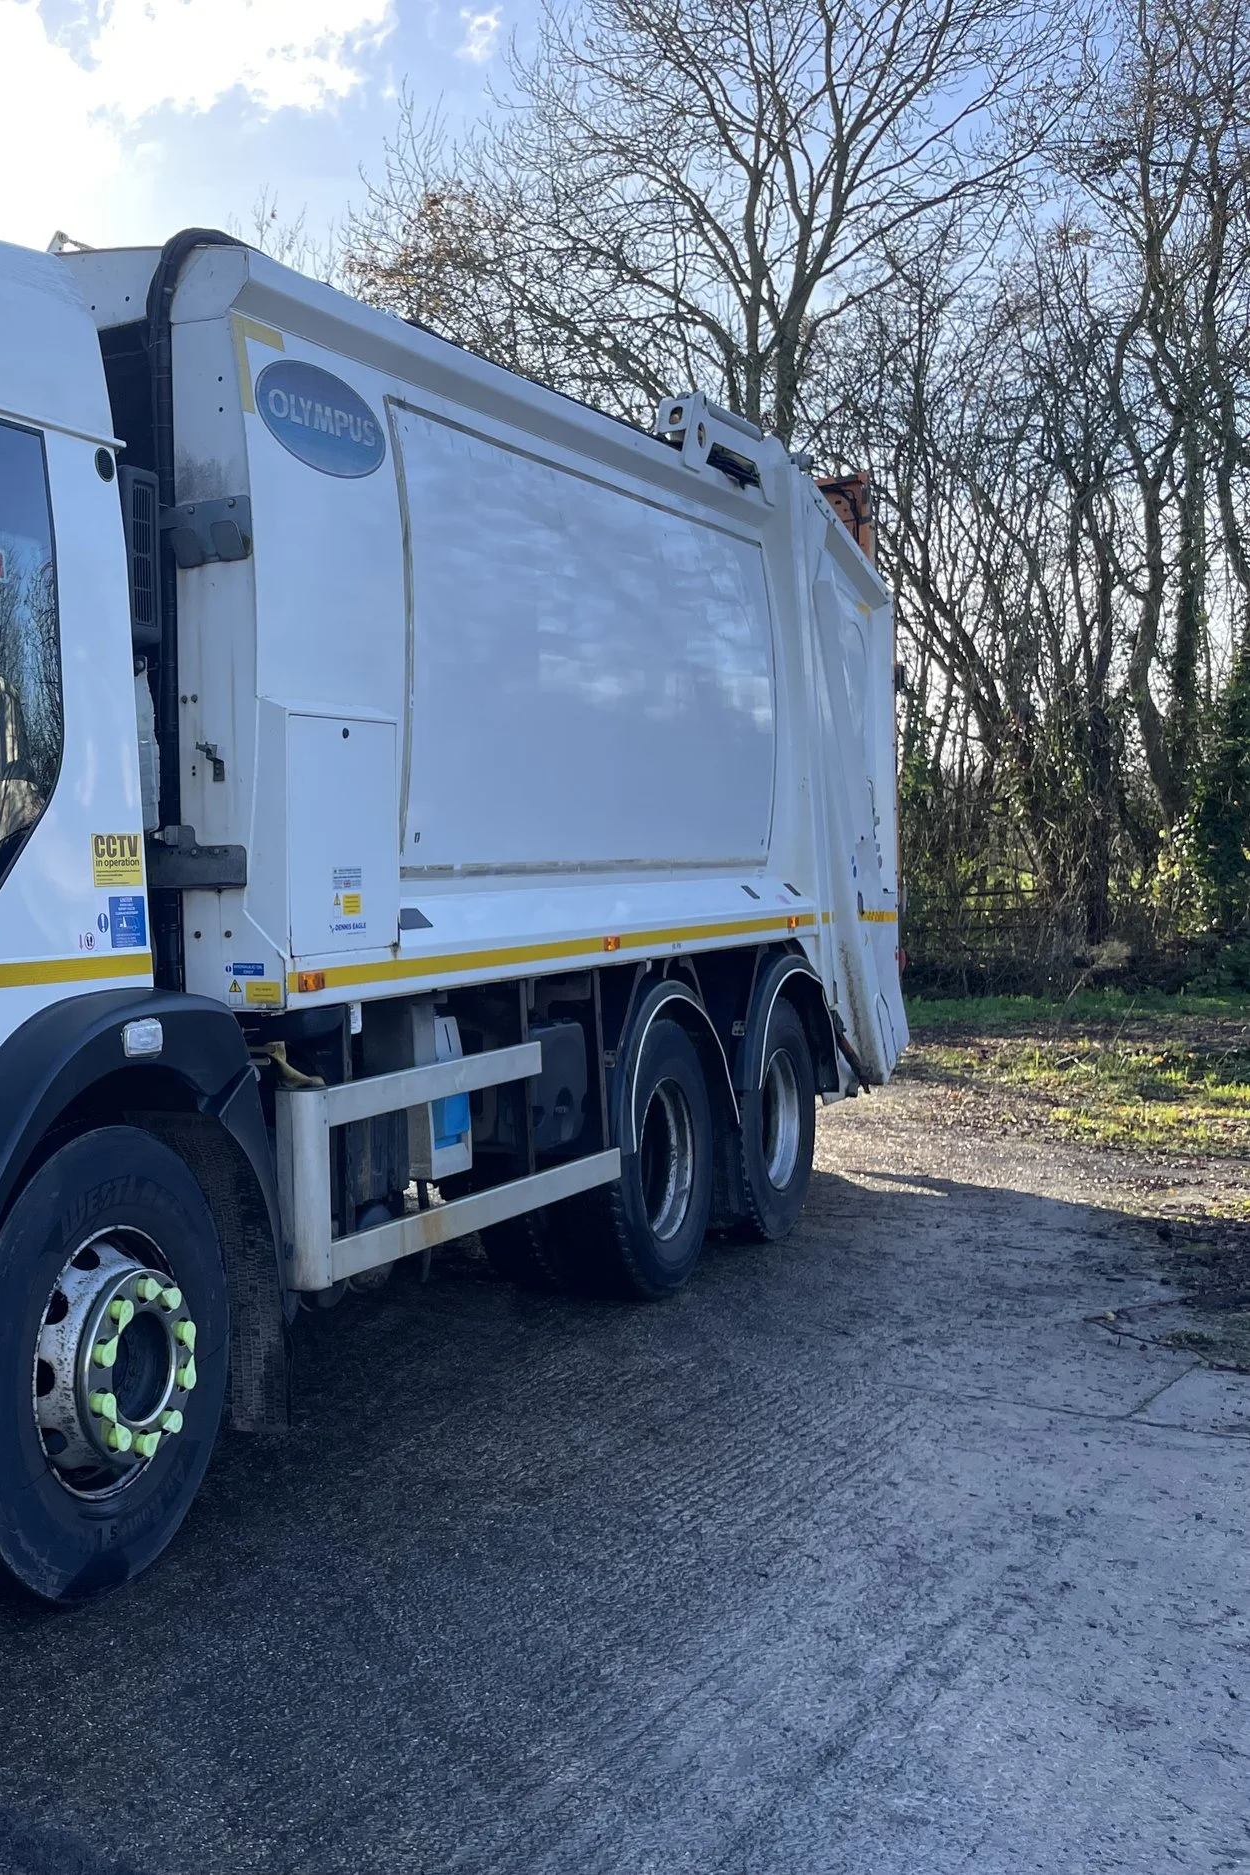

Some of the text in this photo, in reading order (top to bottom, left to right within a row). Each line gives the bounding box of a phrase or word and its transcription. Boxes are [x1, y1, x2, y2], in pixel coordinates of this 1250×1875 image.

[268, 388, 377, 447] OLYMPUS
[94, 835, 138, 858] CCTV
[95, 857, 140, 869] in operation
[335, 923, 351, 931] DENNIS
